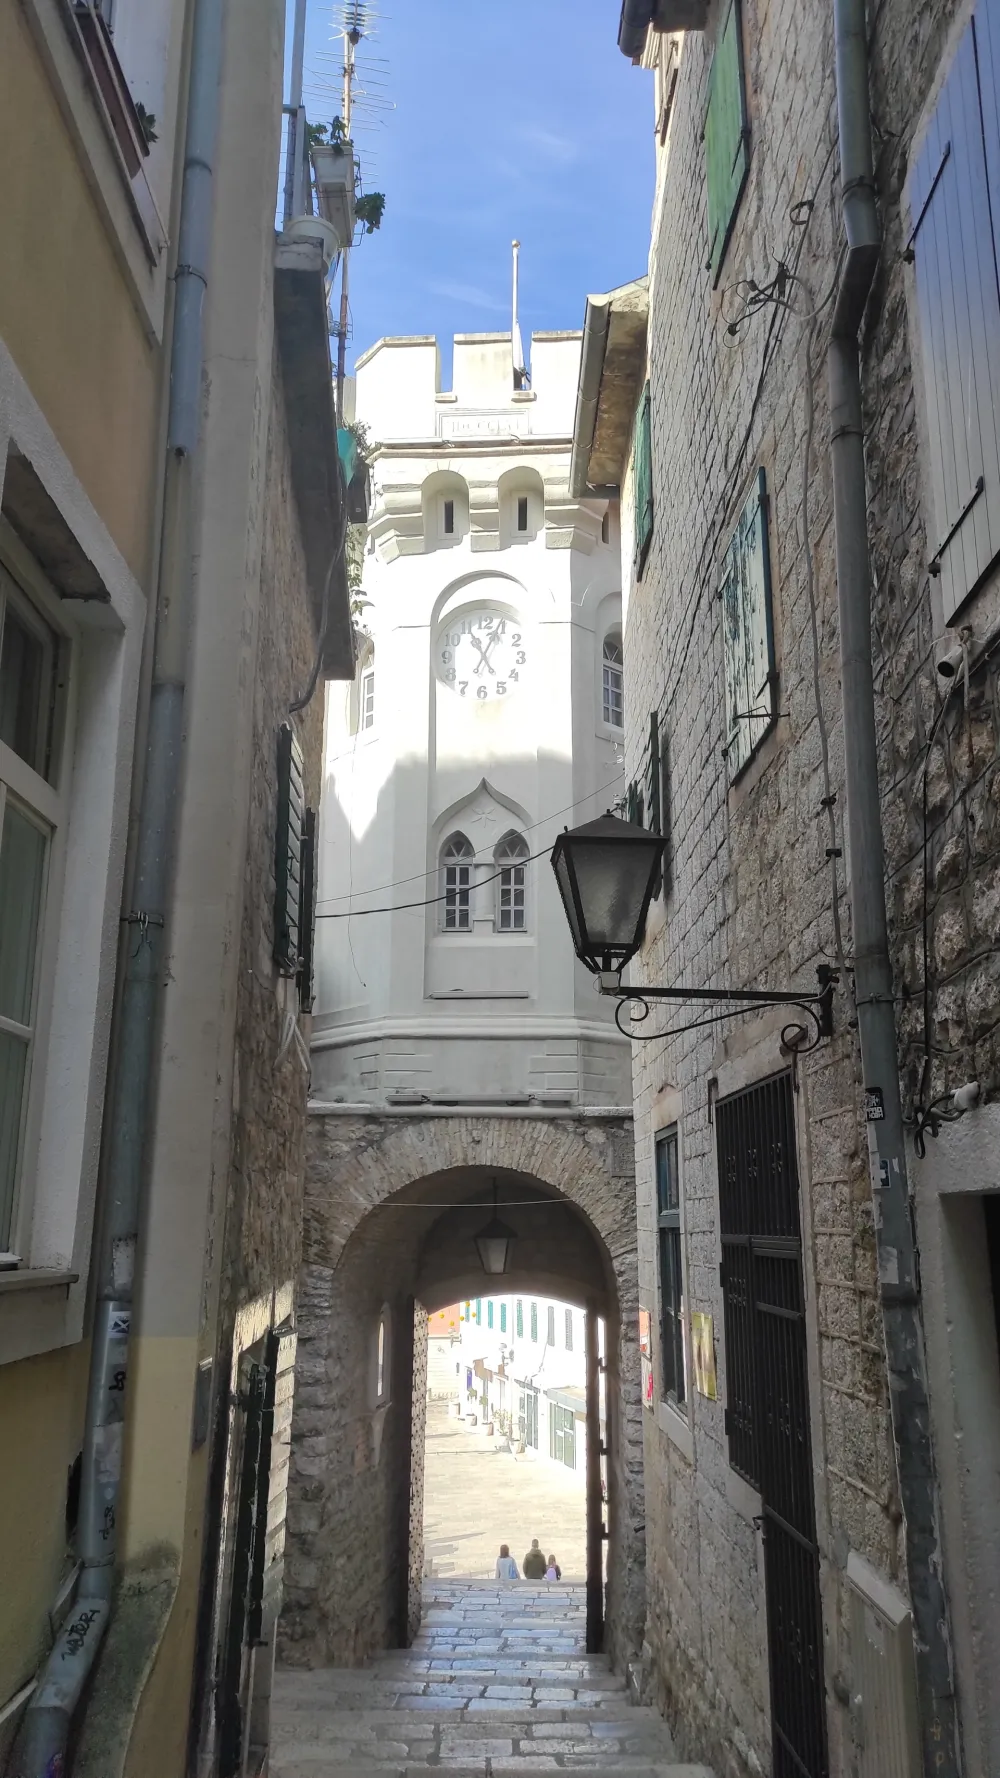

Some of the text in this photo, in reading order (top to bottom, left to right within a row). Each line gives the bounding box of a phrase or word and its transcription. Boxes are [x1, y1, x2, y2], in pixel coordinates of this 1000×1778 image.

[461, 620, 473, 634] 11
[477, 616, 494, 630] 12
[500, 620, 507, 634] 1
[445, 633, 461, 647] 10
[511, 633, 522, 647] 2
[441, 651, 453, 664] 9
[516, 651, 527, 664] 3
[445, 668, 457, 681] 8
[508, 668, 519, 682] 4
[459, 681, 469, 695] 7
[477, 685, 488, 699] 6
[496, 681, 507, 695] 5
